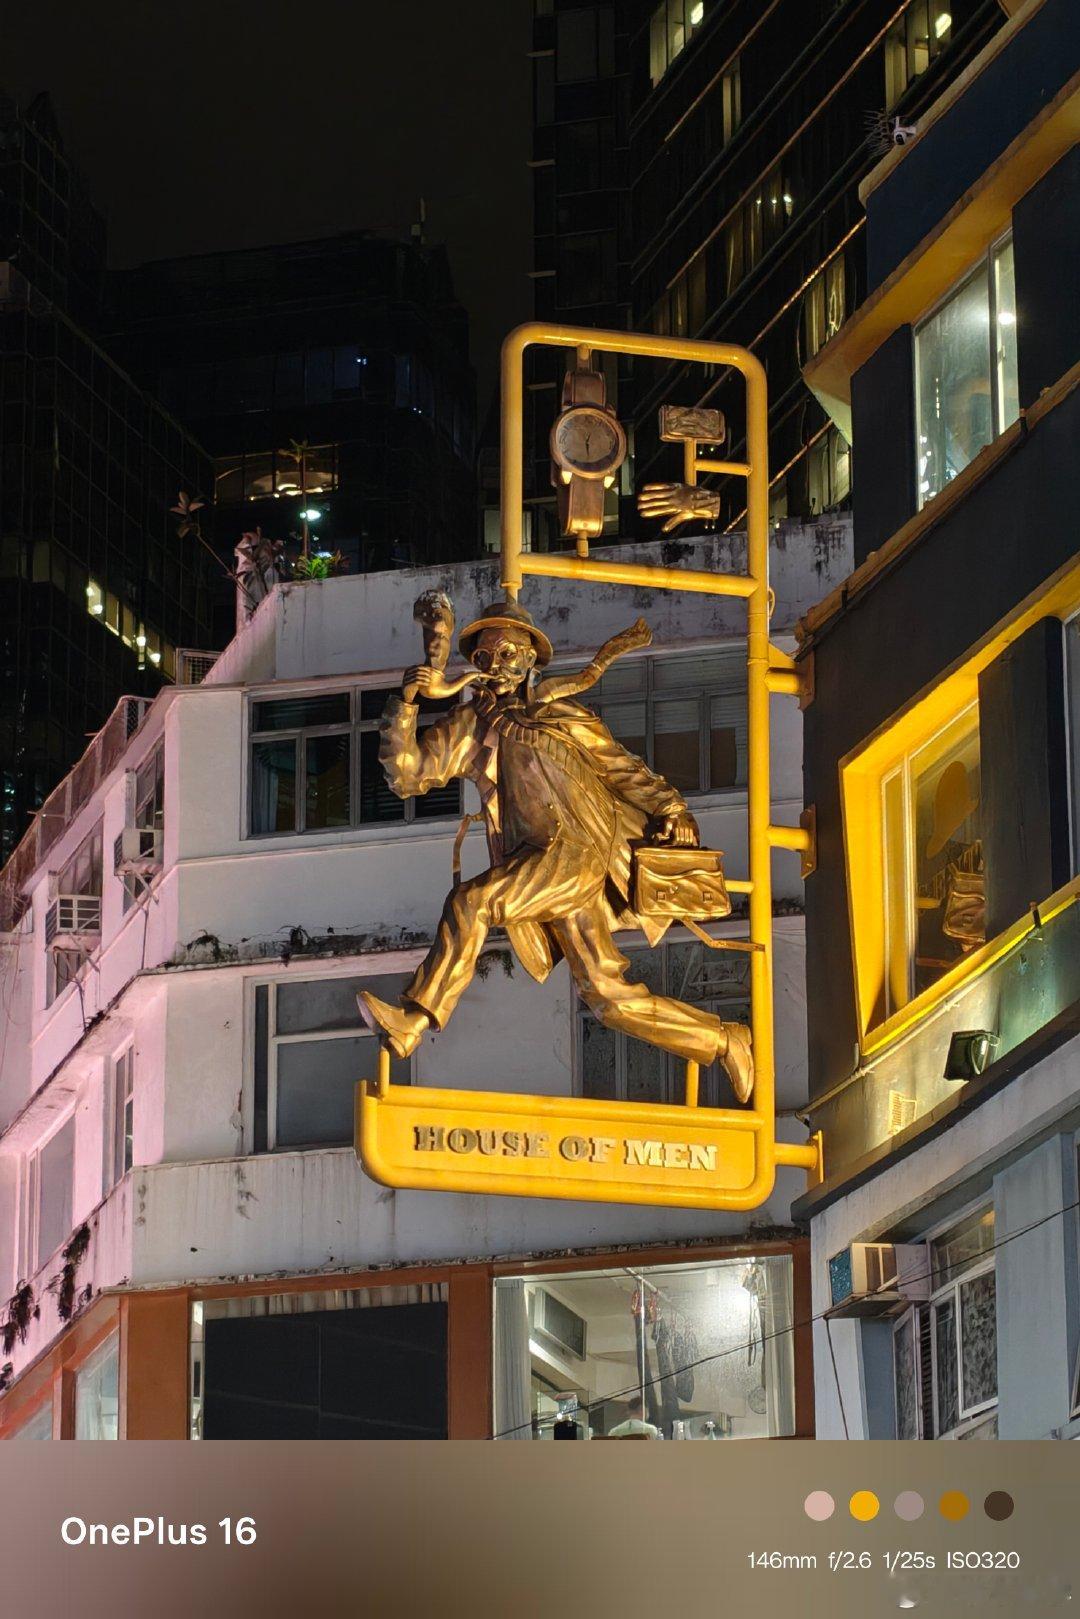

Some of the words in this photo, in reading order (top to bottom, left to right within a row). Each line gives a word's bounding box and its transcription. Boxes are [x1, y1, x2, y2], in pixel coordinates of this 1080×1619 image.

[414, 1125, 550, 1157] HOUSE
[559, 1135, 615, 1163] OF
[623, 1139, 718, 1171] MEN
